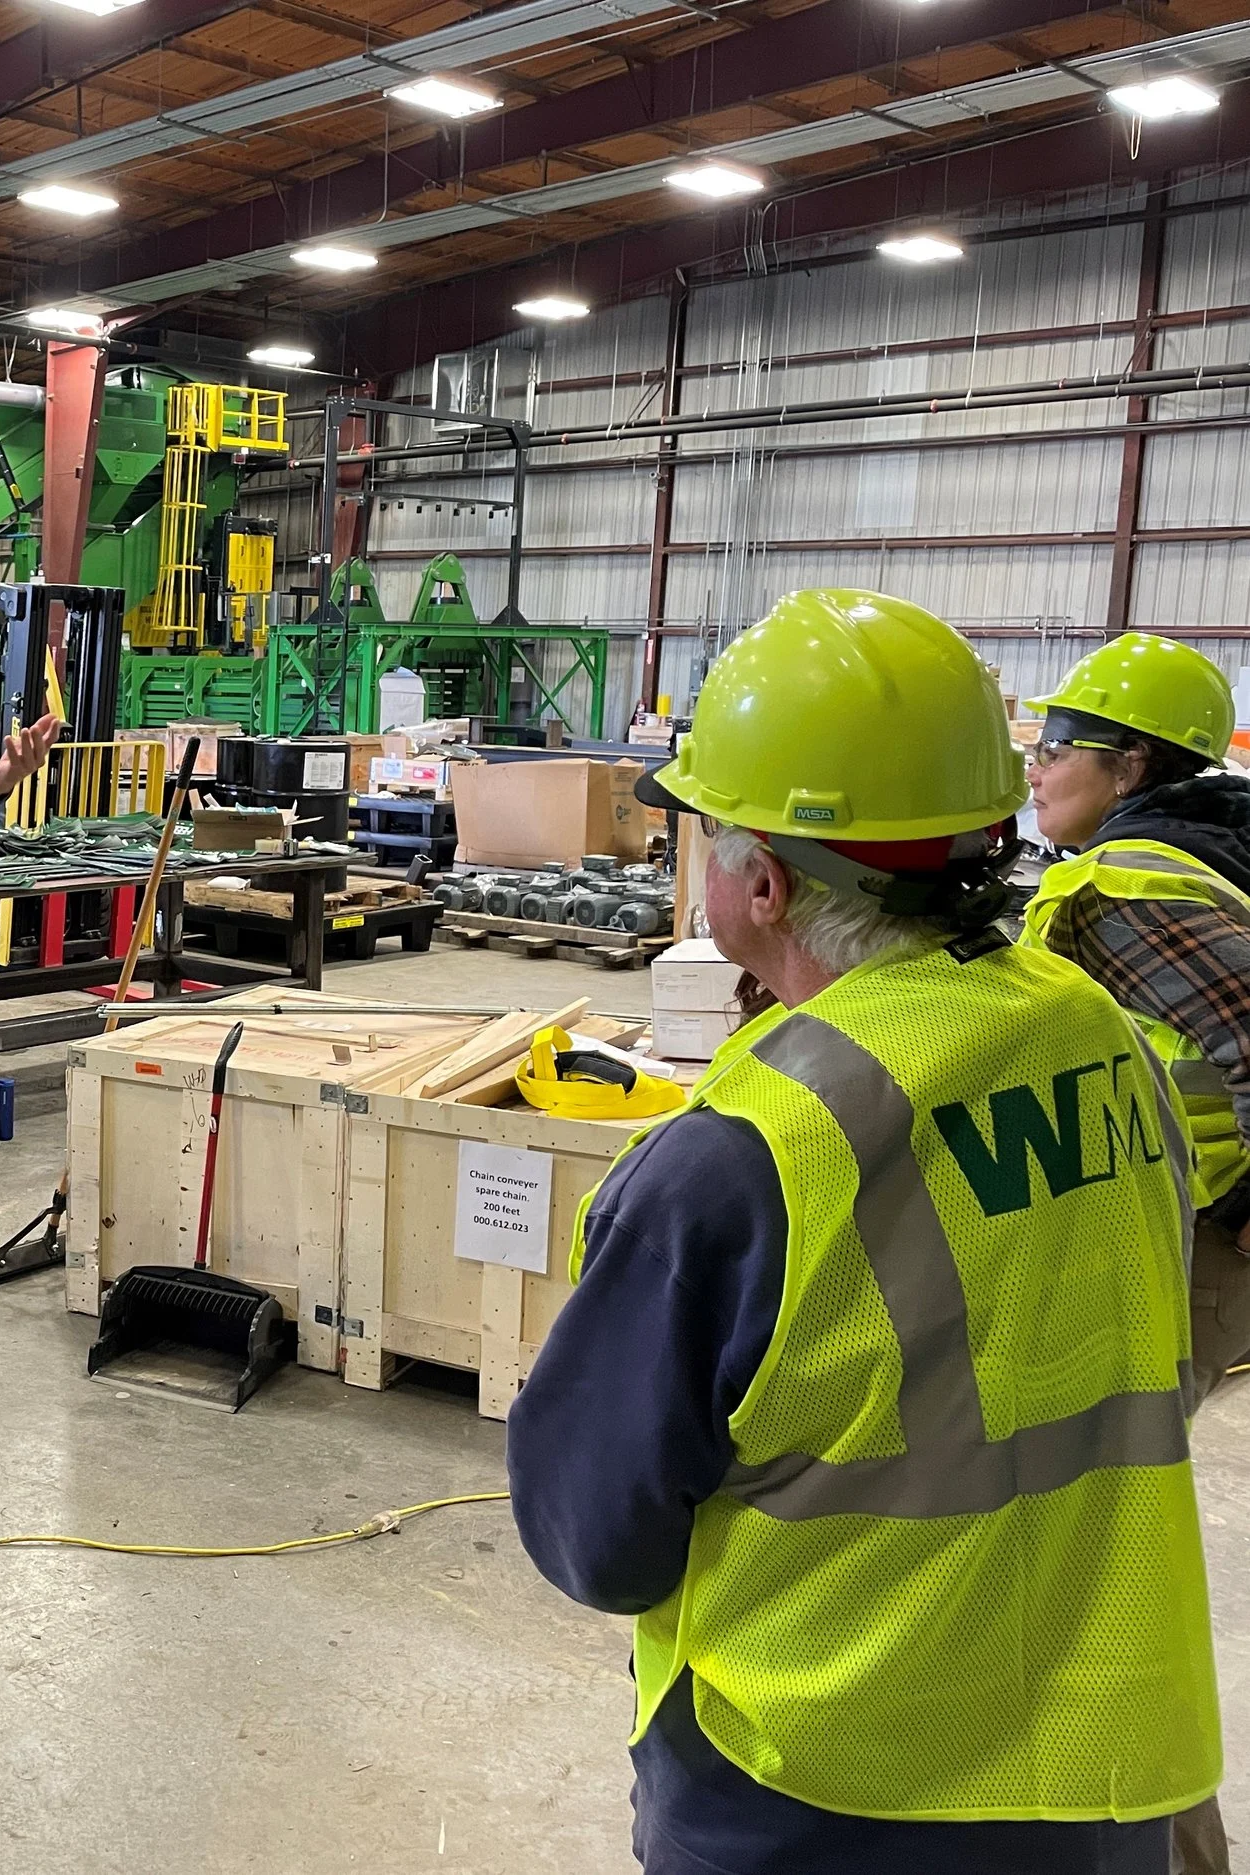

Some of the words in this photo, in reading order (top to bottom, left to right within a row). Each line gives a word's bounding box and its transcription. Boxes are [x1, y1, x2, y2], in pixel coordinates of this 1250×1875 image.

[796, 808, 833, 820] MSA
[469, 1169, 495, 1182] Chain
[497, 1176, 539, 1190] conveyer
[475, 1186, 501, 1196] spare
[502, 1190, 530, 1203] chain.
[483, 1201, 501, 1213] 200
[502, 1205, 521, 1217] feet
[473, 1215, 529, 1233] 000.612.023
